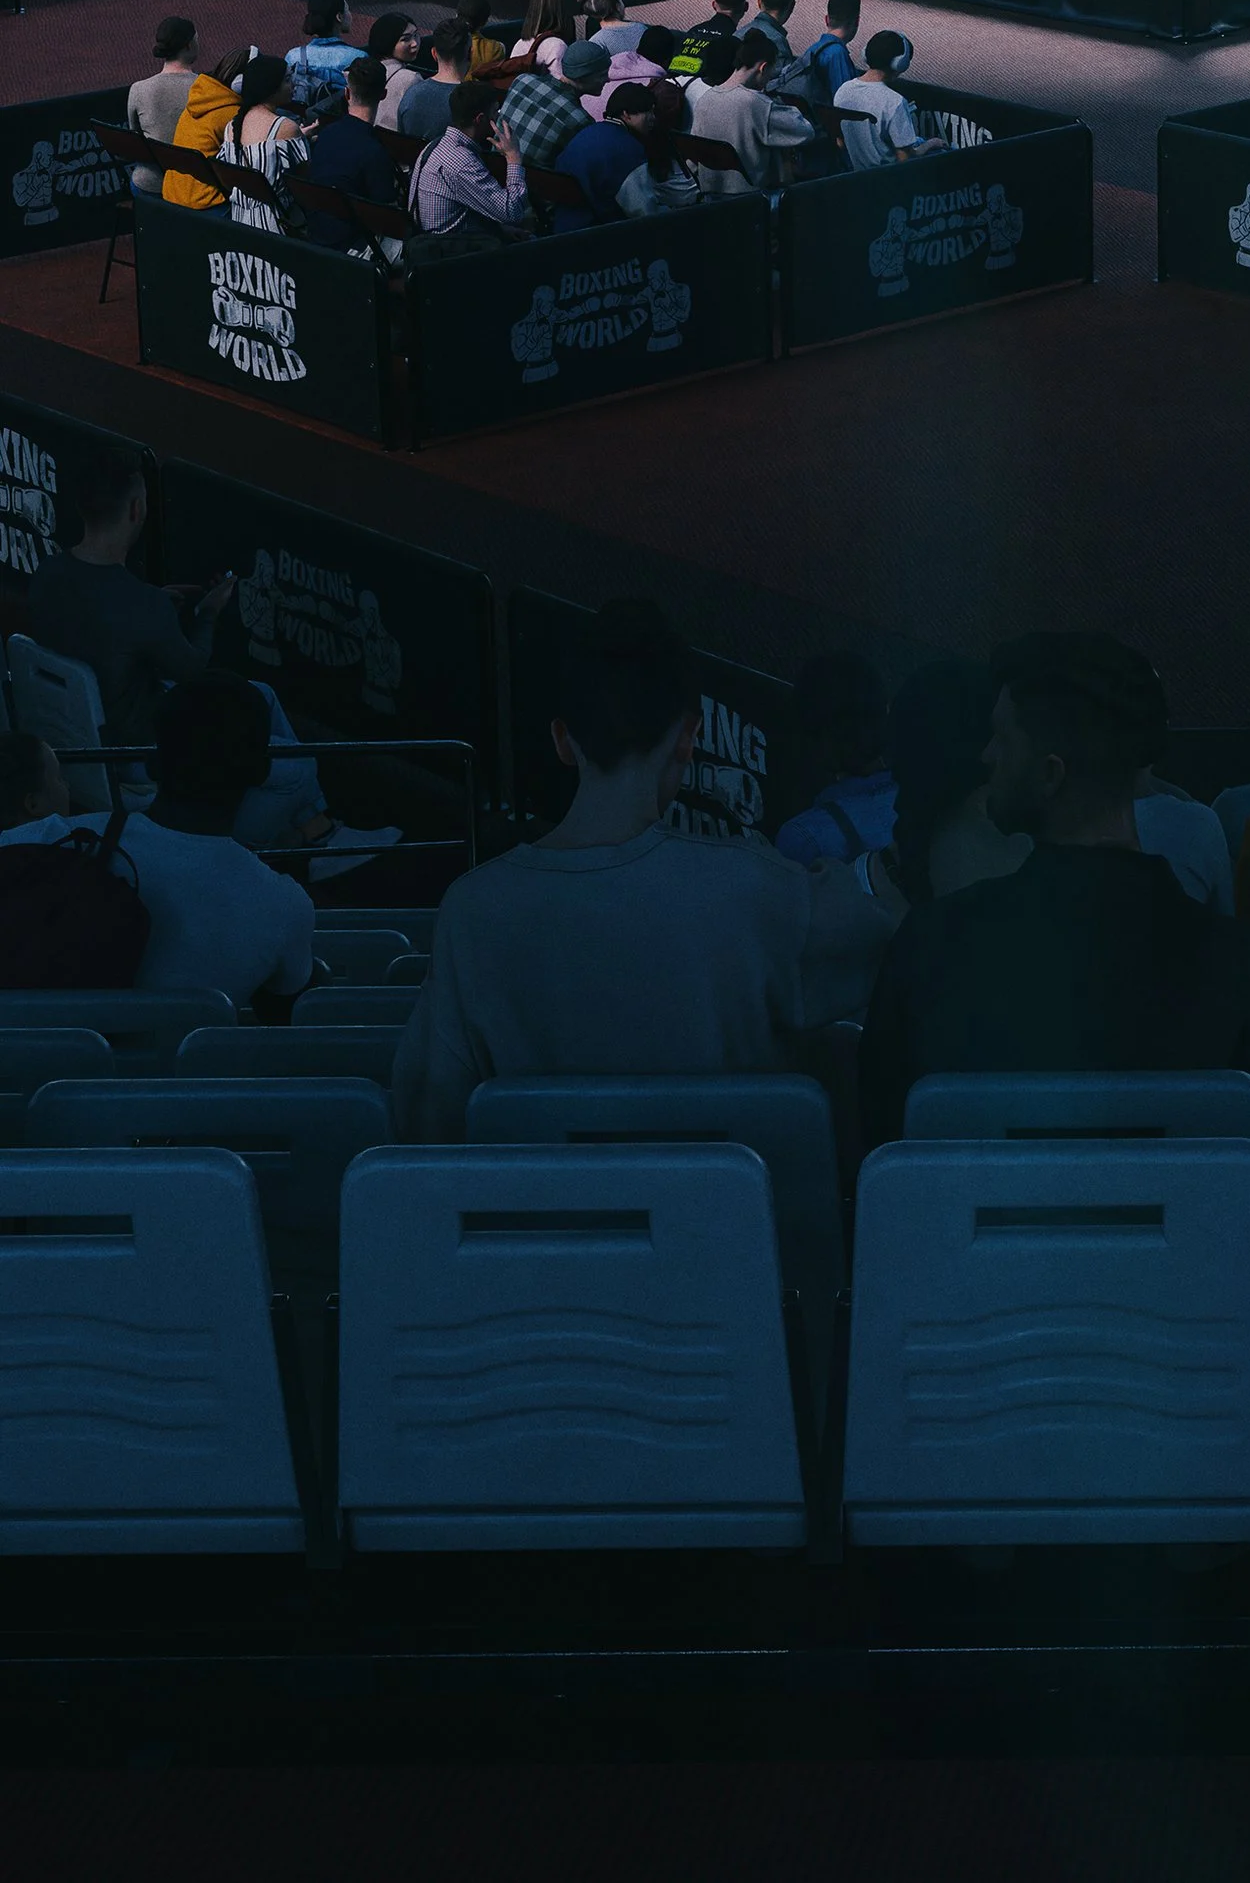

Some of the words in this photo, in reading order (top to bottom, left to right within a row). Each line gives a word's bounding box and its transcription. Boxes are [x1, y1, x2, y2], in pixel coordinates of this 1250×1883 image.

[911, 182, 983, 221] BOXING
[906, 228, 987, 267] WORLD
[208, 251, 297, 310] BOXING
[559, 256, 644, 301] BOXING
[208, 323, 307, 382] WORLD
[555, 307, 649, 350] WORLD
[278, 548, 356, 608] BOXING
[277, 612, 363, 667] WORLD
